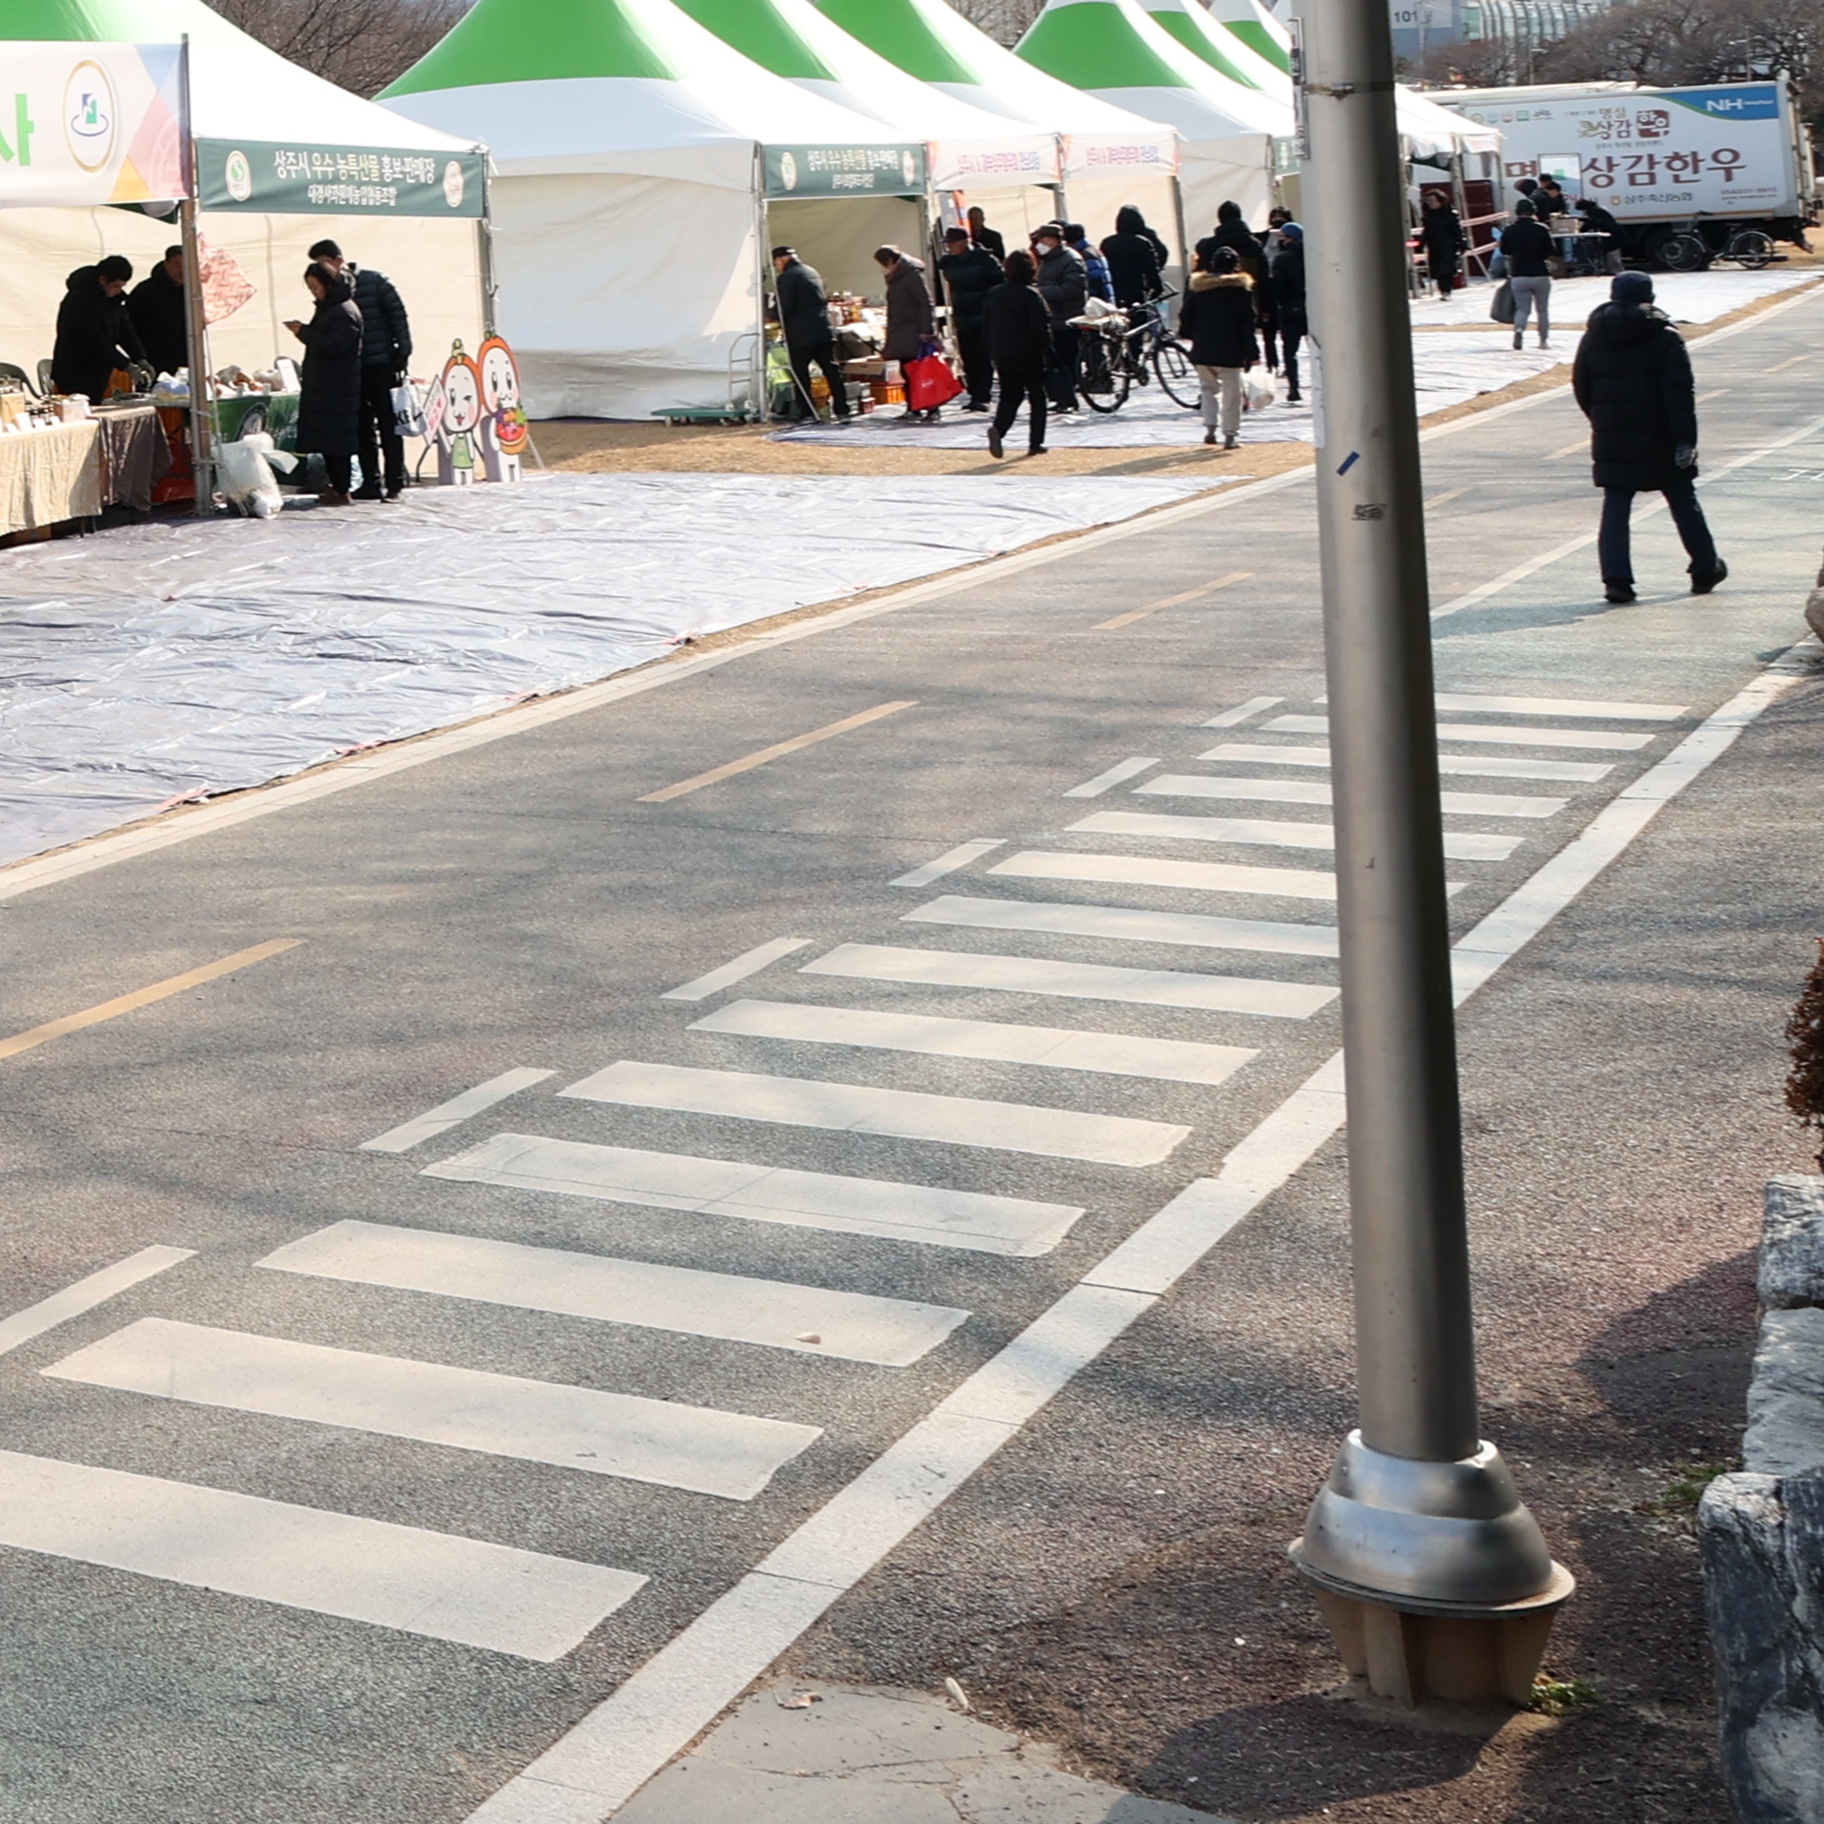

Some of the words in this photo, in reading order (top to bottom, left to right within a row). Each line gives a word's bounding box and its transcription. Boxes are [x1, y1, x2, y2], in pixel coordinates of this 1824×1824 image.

[1706, 98, 1744, 112] NH
[273, 150, 311, 179] 상주시
[312, 152, 335, 179] 우수
[336, 153, 381, 182] 농특산물
